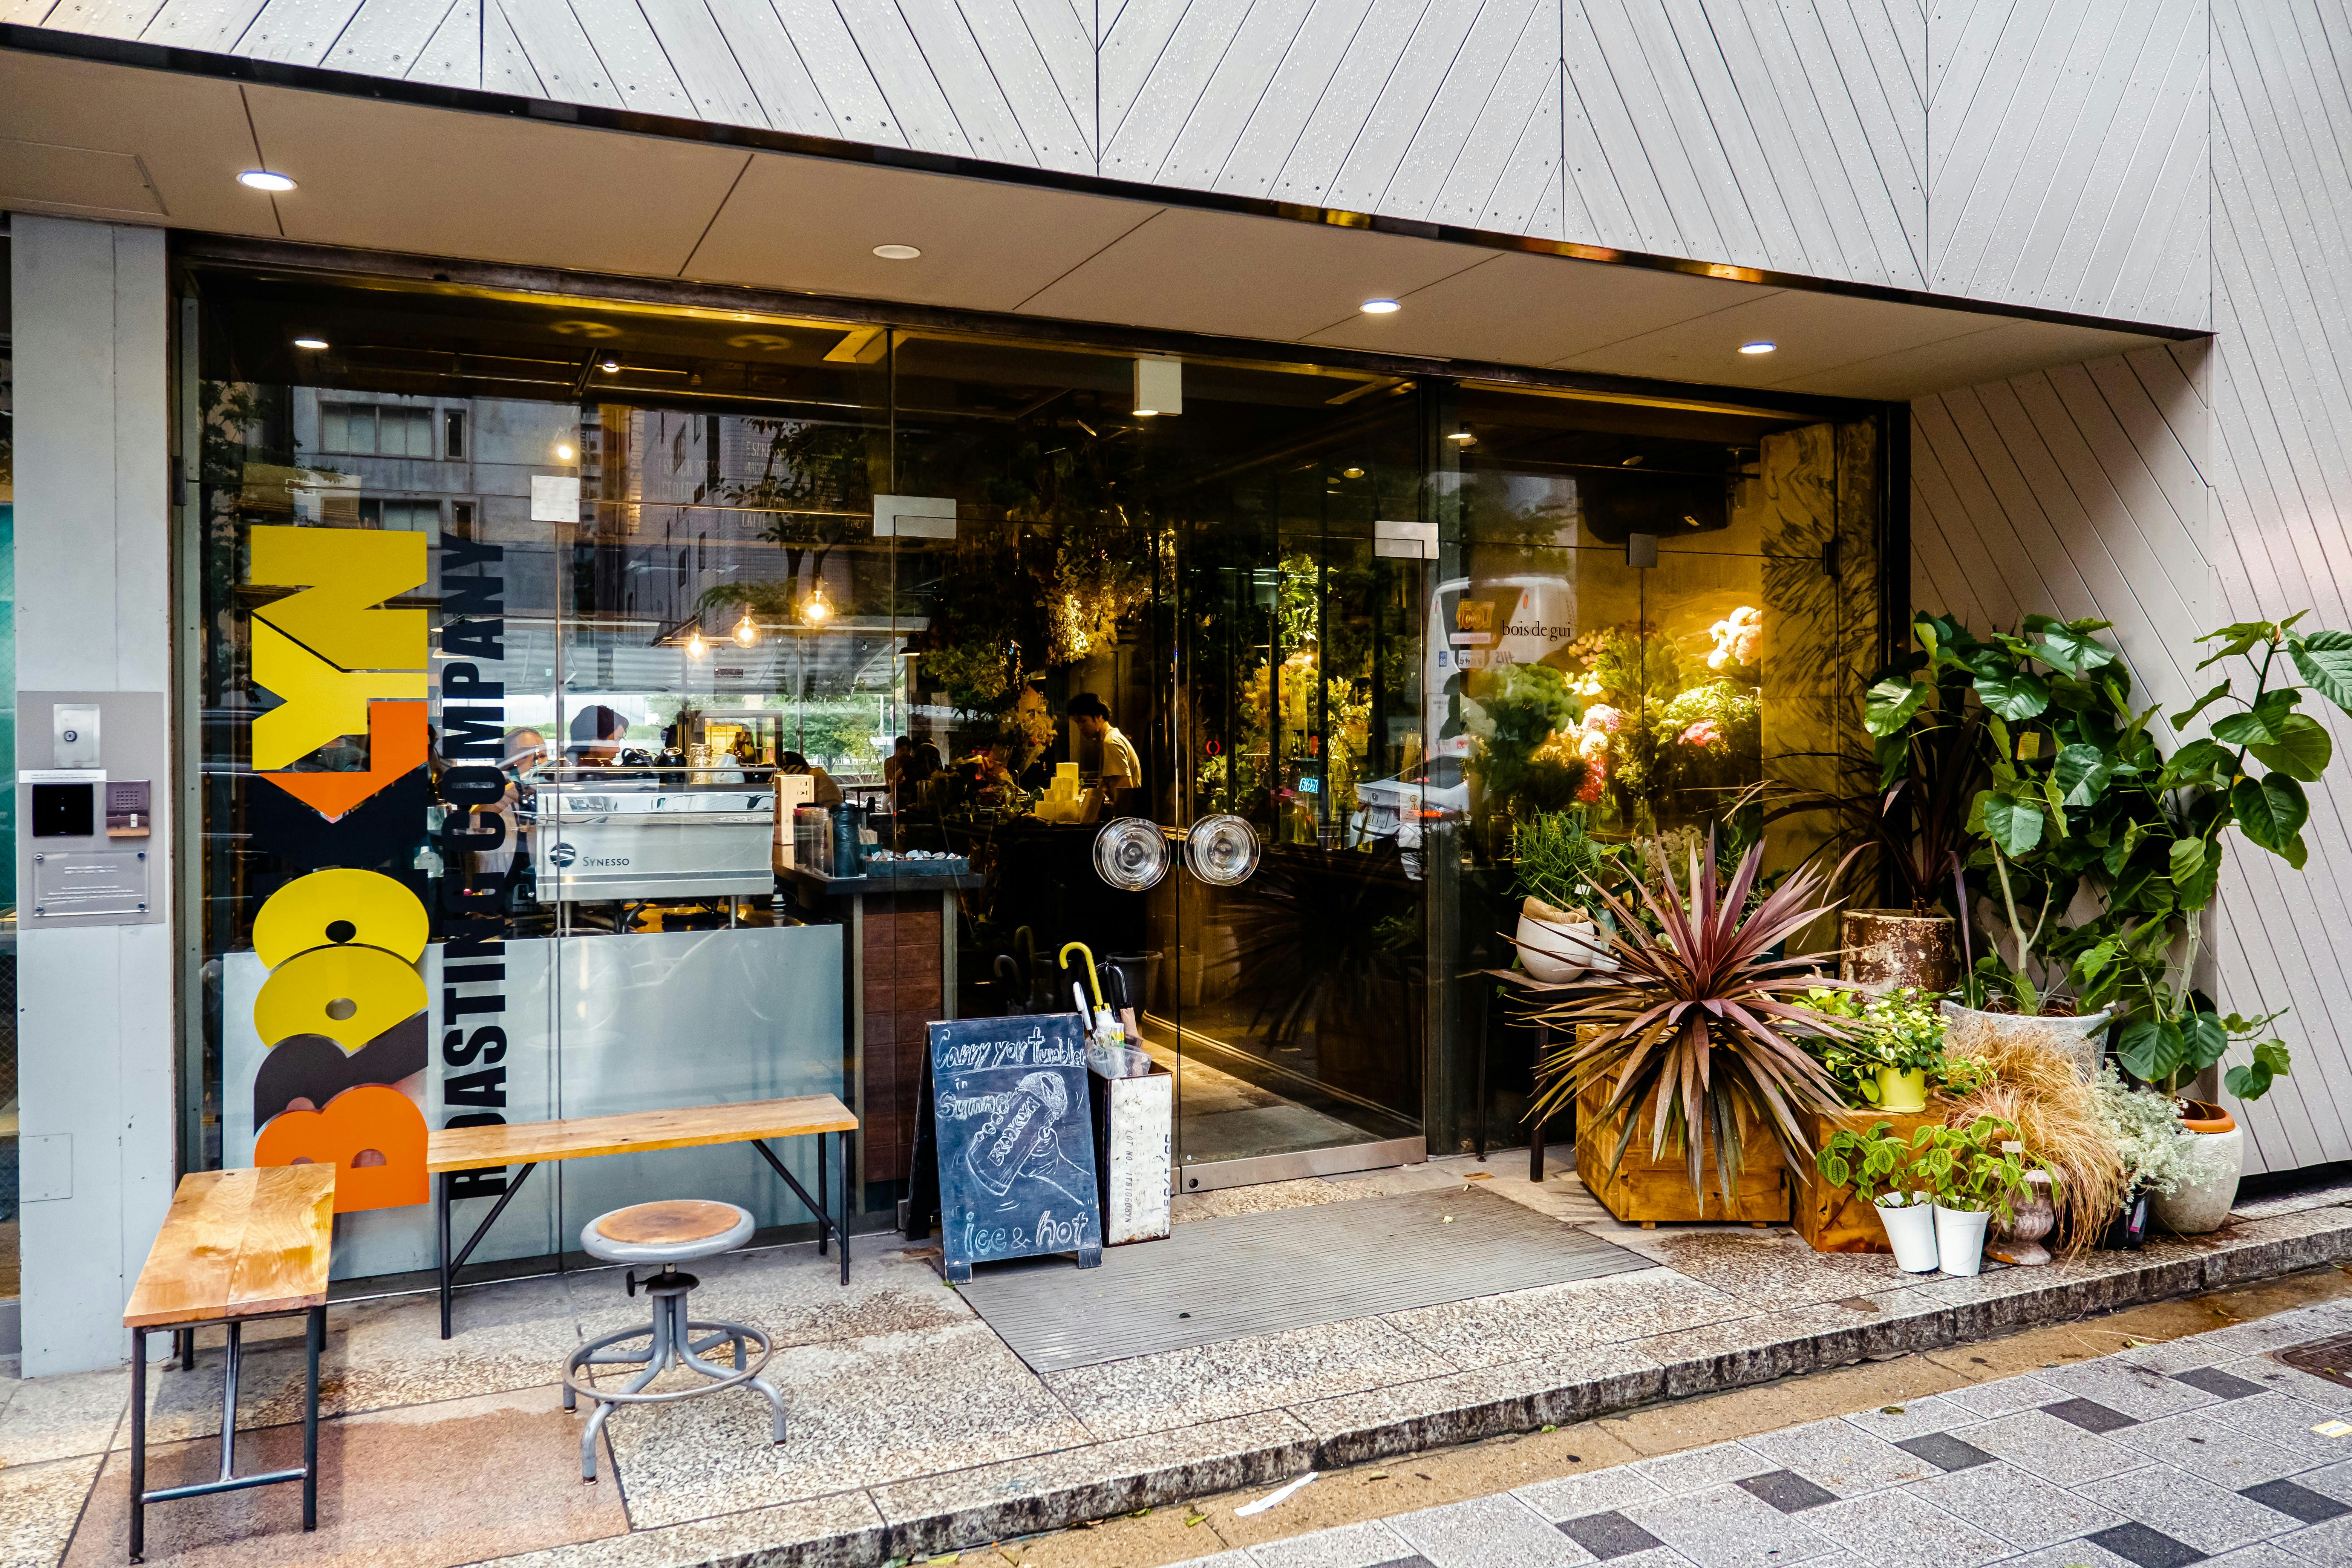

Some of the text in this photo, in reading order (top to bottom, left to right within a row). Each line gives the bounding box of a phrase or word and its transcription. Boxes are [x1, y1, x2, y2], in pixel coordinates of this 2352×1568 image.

[742, 513, 767, 529] LATTE
[1502, 620, 1571, 642] bois de gui
[441, 531, 505, 851] COMPANY
[252, 525, 429, 1213] BROOKLYN
[934, 1029, 991, 1069] Carry
[954, 1078, 968, 1090] in
[964, 1210, 1089, 1258] ice & hot
